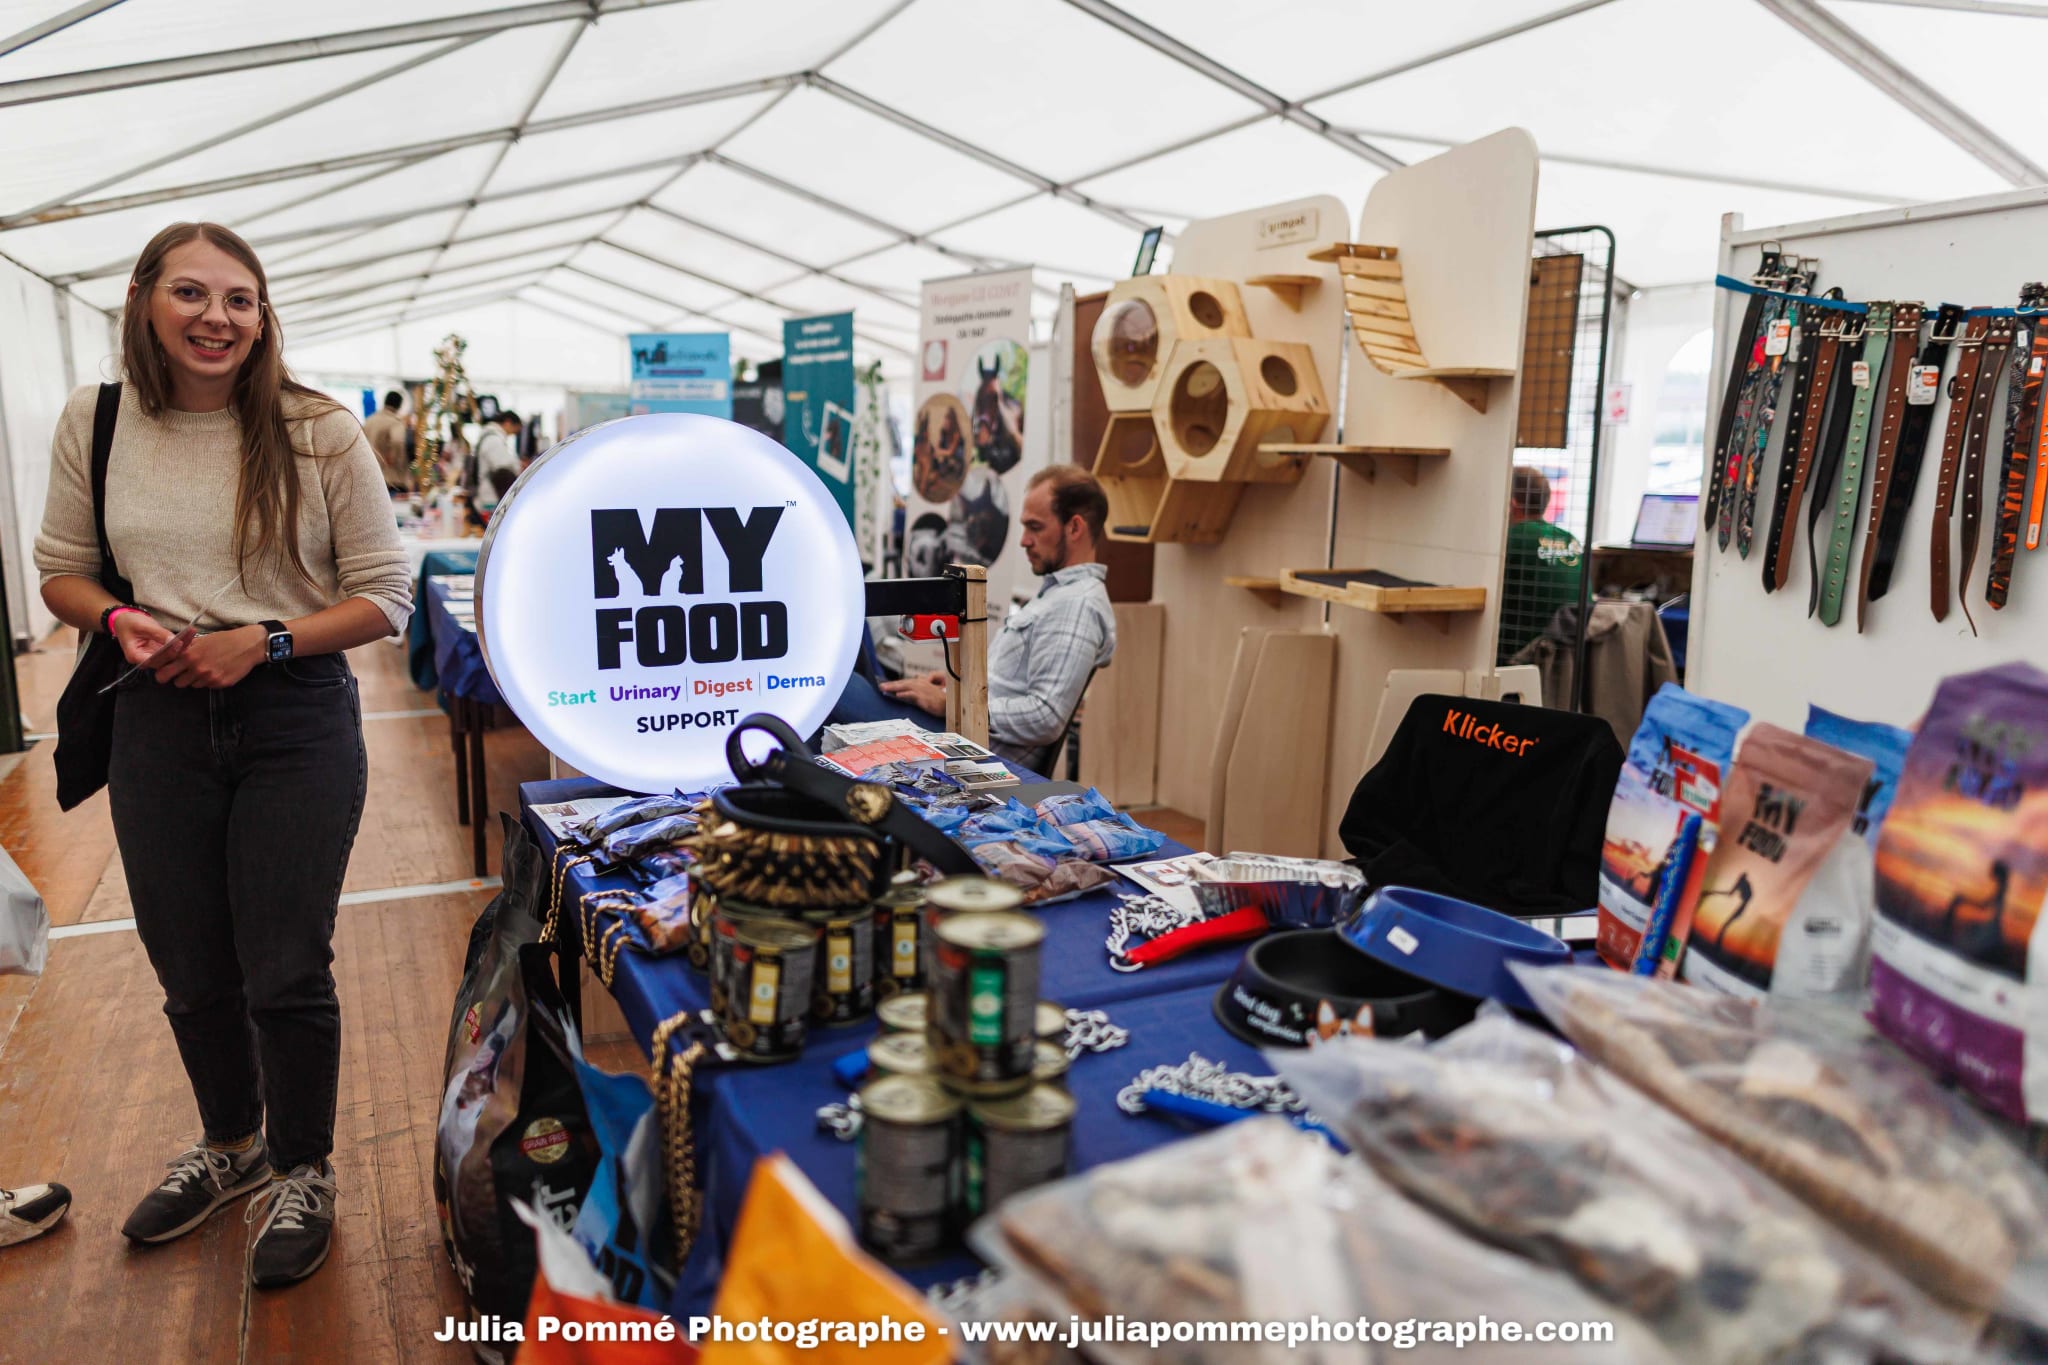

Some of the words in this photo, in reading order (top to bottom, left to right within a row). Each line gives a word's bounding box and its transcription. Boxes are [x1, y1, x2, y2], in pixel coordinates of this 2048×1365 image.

[591, 507, 785, 599] MY
[596, 601, 788, 670] FOOD
[548, 690, 597, 707] Start
[610, 685, 681, 702] Urinary
[694, 678, 753, 698] Digest
[767, 673, 826, 690] Derma
[637, 709, 740, 733] SUPPORT
[1443, 709, 1535, 757] Klicker
